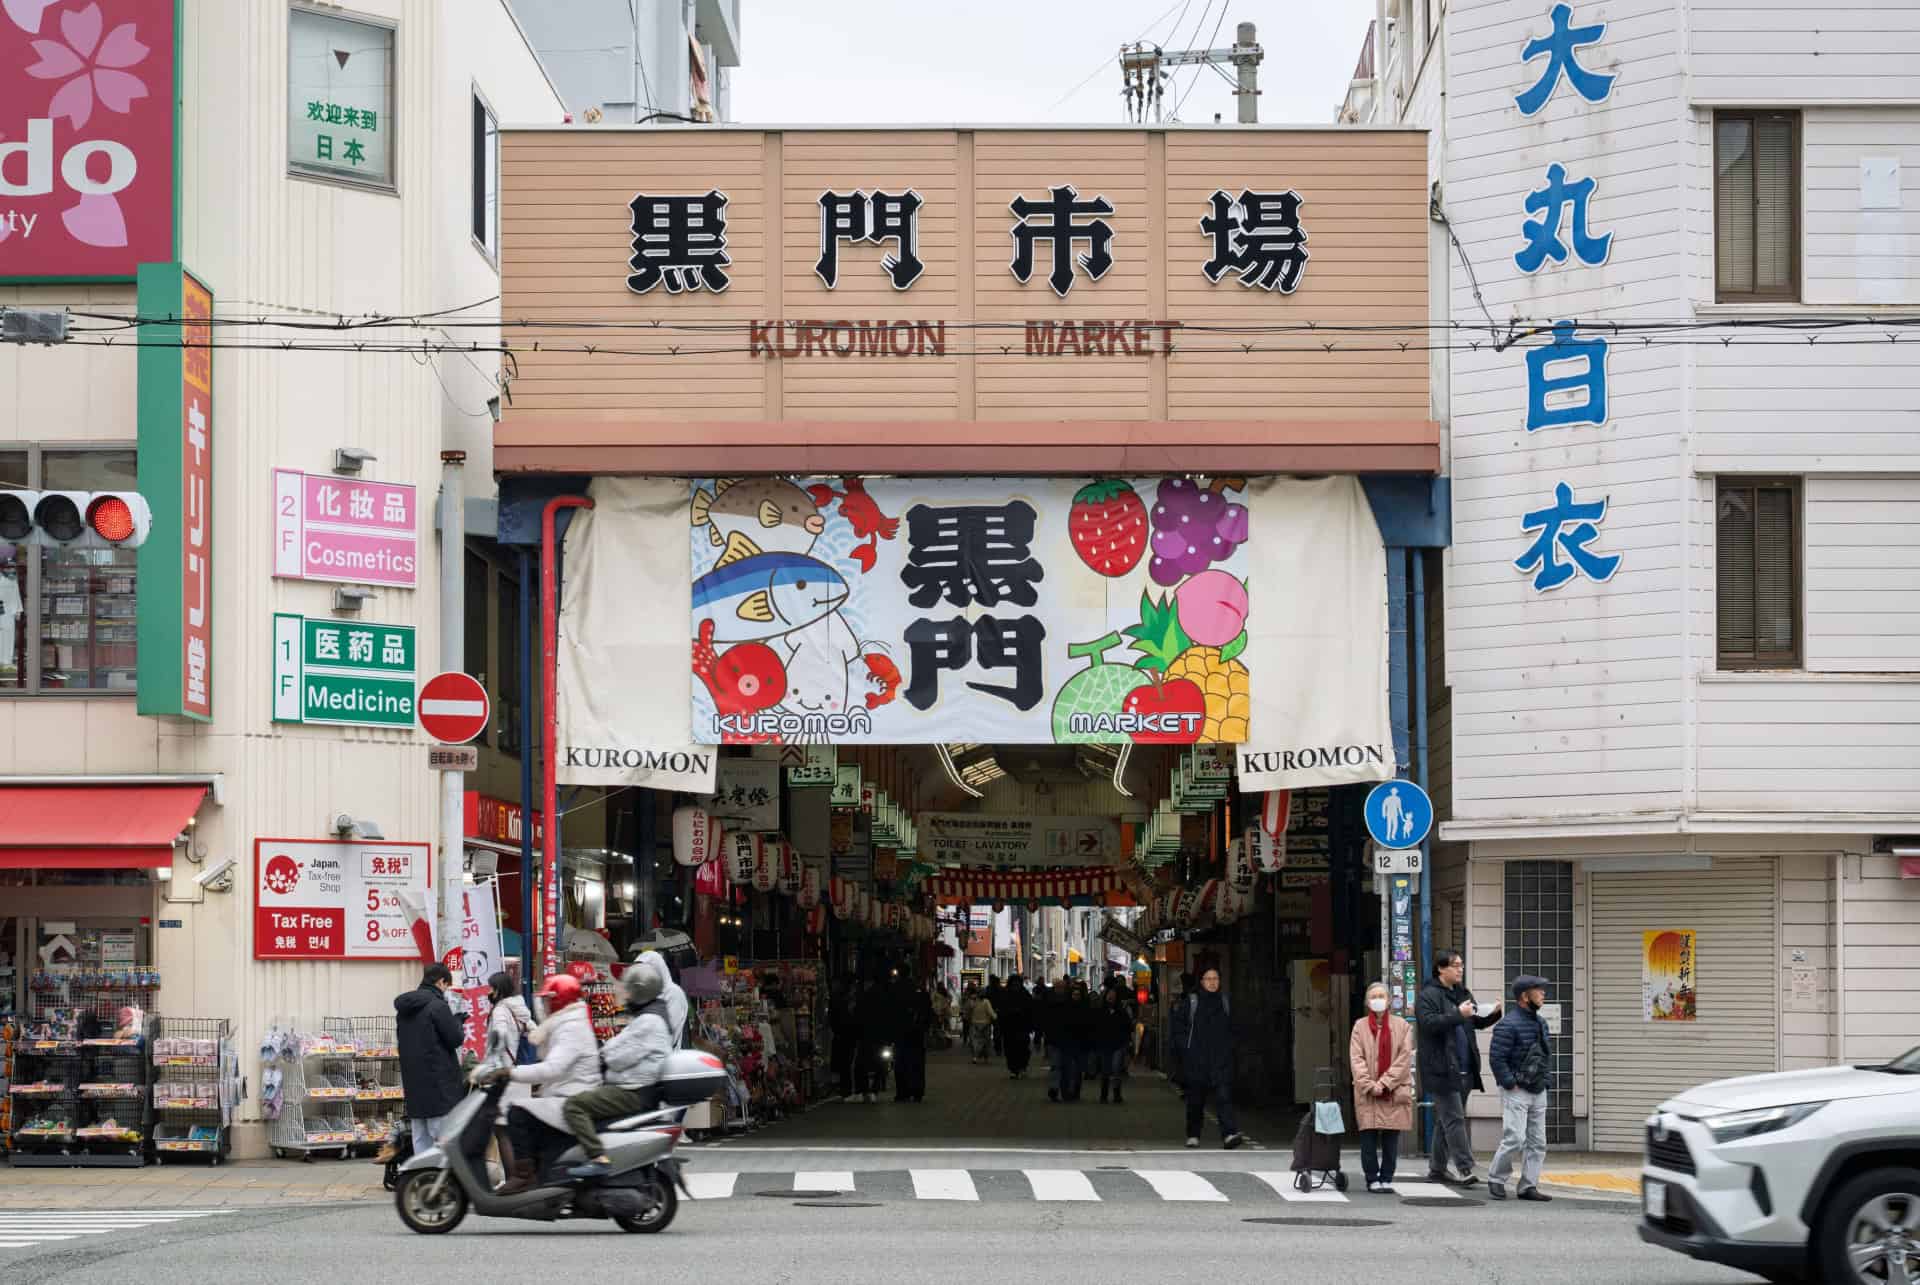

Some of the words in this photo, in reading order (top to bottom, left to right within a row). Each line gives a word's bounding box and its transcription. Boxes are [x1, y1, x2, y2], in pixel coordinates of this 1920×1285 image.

[307, 100, 377, 131] 欢迎来到
[316, 134, 365, 166] 日本
[629, 185, 1311, 297] 黒門市場
[1514, 2, 1621, 591] 大丸白衣
[750, 318, 945, 358] KUROMON
[1025, 318, 1178, 358] MARKET
[307, 541, 414, 573] Cosmetics
[899, 500, 1047, 711] 黒門
[308, 686, 412, 715] Medicine
[713, 712, 872, 735] KUROMON
[1070, 711, 1202, 734] MARKET
[565, 745, 711, 776] KUROMON
[1243, 744, 1385, 774] KUROMON
[976, 841, 1028, 850] LAVATORY
[307, 871, 341, 881] Tax-free
[1379, 855, 1391, 868] 12
[1407, 855, 1419, 868] 18
[319, 883, 341, 893] Shop
[272, 914, 297, 929] Tax
[301, 915, 333, 929] Free
